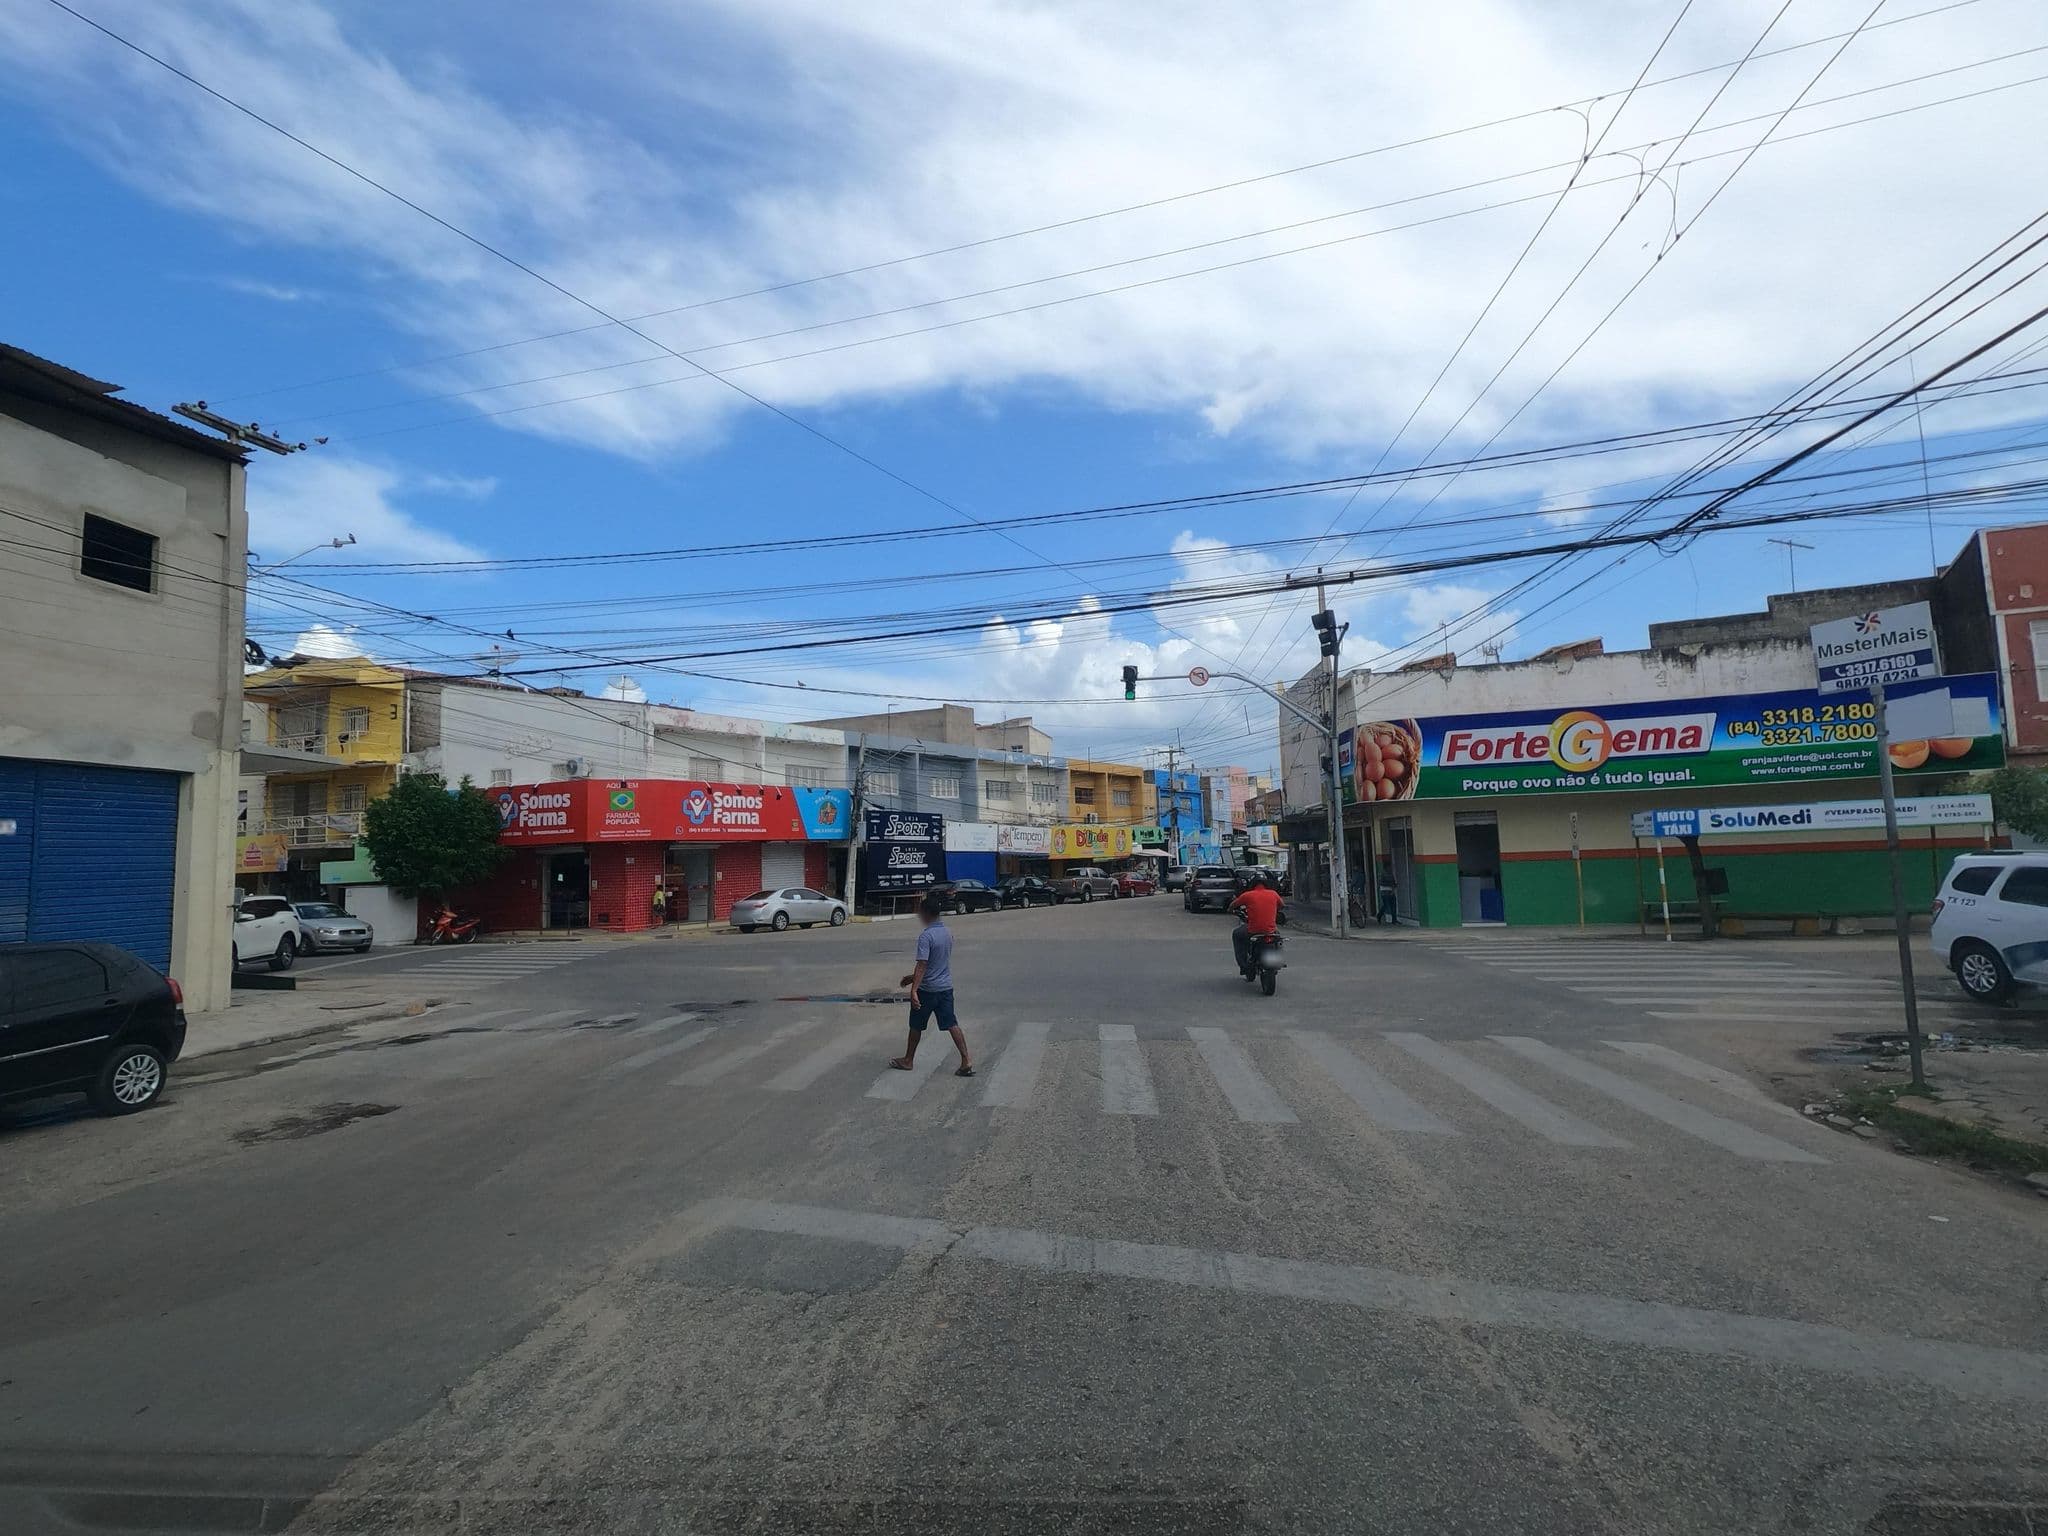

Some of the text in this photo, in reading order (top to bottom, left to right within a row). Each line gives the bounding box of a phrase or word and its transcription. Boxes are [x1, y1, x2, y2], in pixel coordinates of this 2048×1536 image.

[1817, 627, 1928, 659] MasterMais
[1845, 654, 1916, 677] 3317.6160
[1762, 702, 1876, 727] 3318.2180
[1728, 721, 1760, 737] (84)
[1762, 722, 1876, 746] 3321.7800
[1751, 762, 1866, 775] www.fortegema.com.br
[1462, 779, 1518, 792] Porque
[1522, 777, 1551, 788] ovo
[1556, 774, 1586, 787] não
[1590, 773, 1600, 785] é
[1605, 772, 1643, 784] tudo
[519, 792, 571, 810] Somos
[712, 791, 763, 809] Somos
[519, 810, 567, 827] Farma
[605, 811, 640, 819] FARMÁCIA
[713, 809, 760, 825] Farma
[1656, 810, 1696, 822] MOTO
[1710, 809, 1812, 828] SoluMedi
[1662, 824, 1692, 836] TÁXI
[1947, 896, 1958, 904] TX
